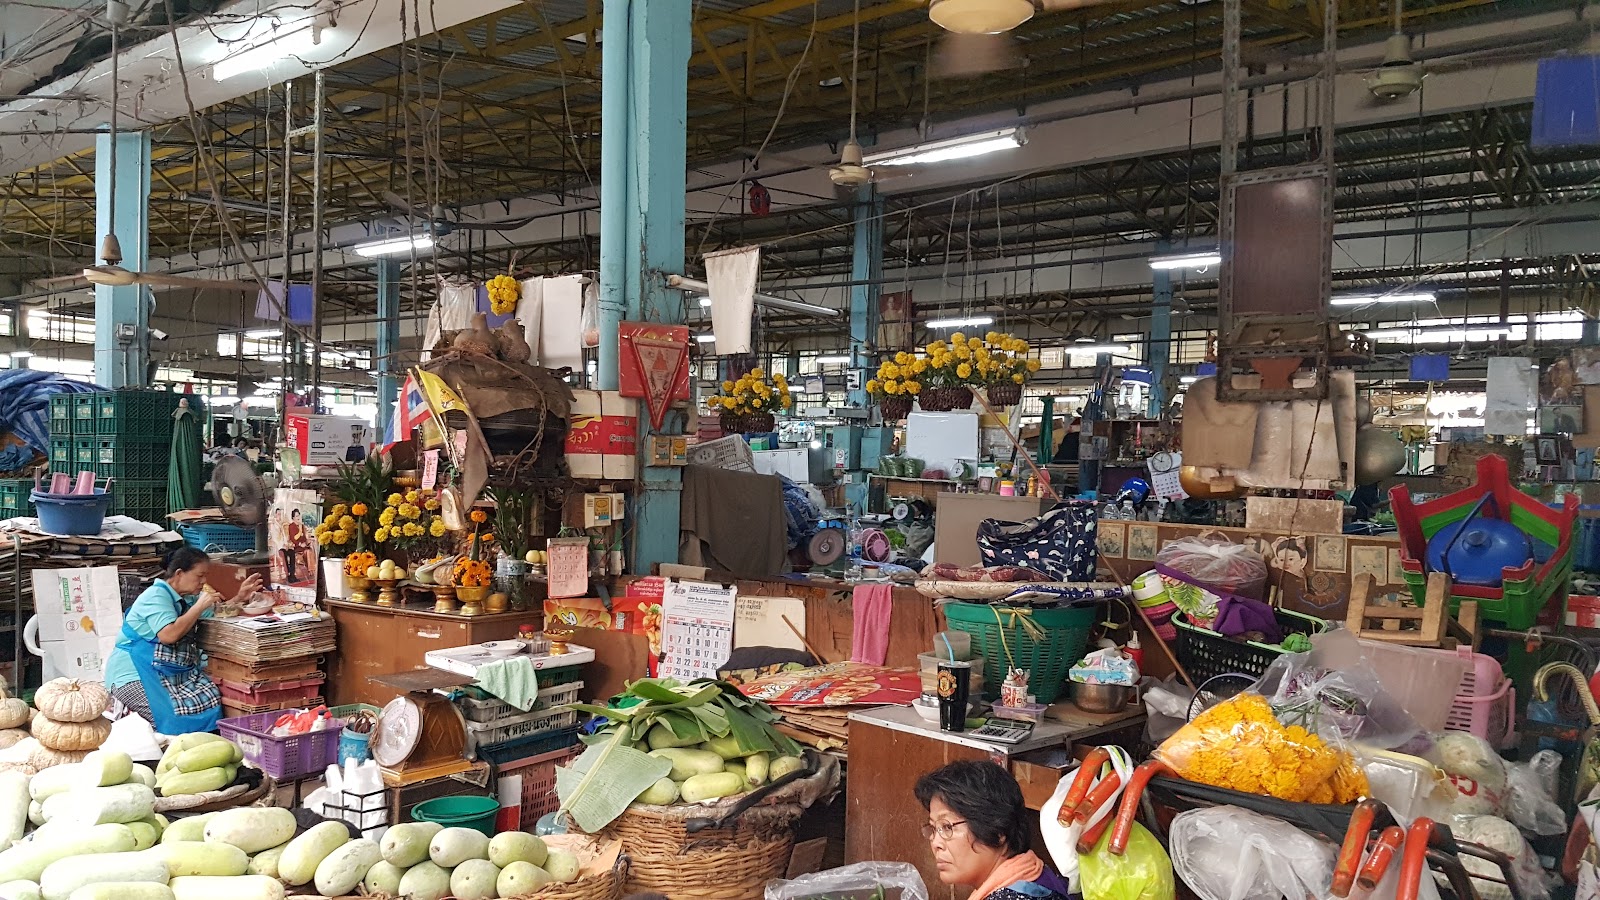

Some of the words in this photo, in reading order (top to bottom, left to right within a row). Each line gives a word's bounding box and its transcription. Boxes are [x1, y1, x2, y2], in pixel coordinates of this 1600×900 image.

[715, 630, 719, 638] 4
[695, 649, 700, 657] 16
[704, 650, 709, 658] 17
[667, 656, 673, 664] 20
[684, 658, 690, 666] 22
[702, 661, 709, 669] 24
